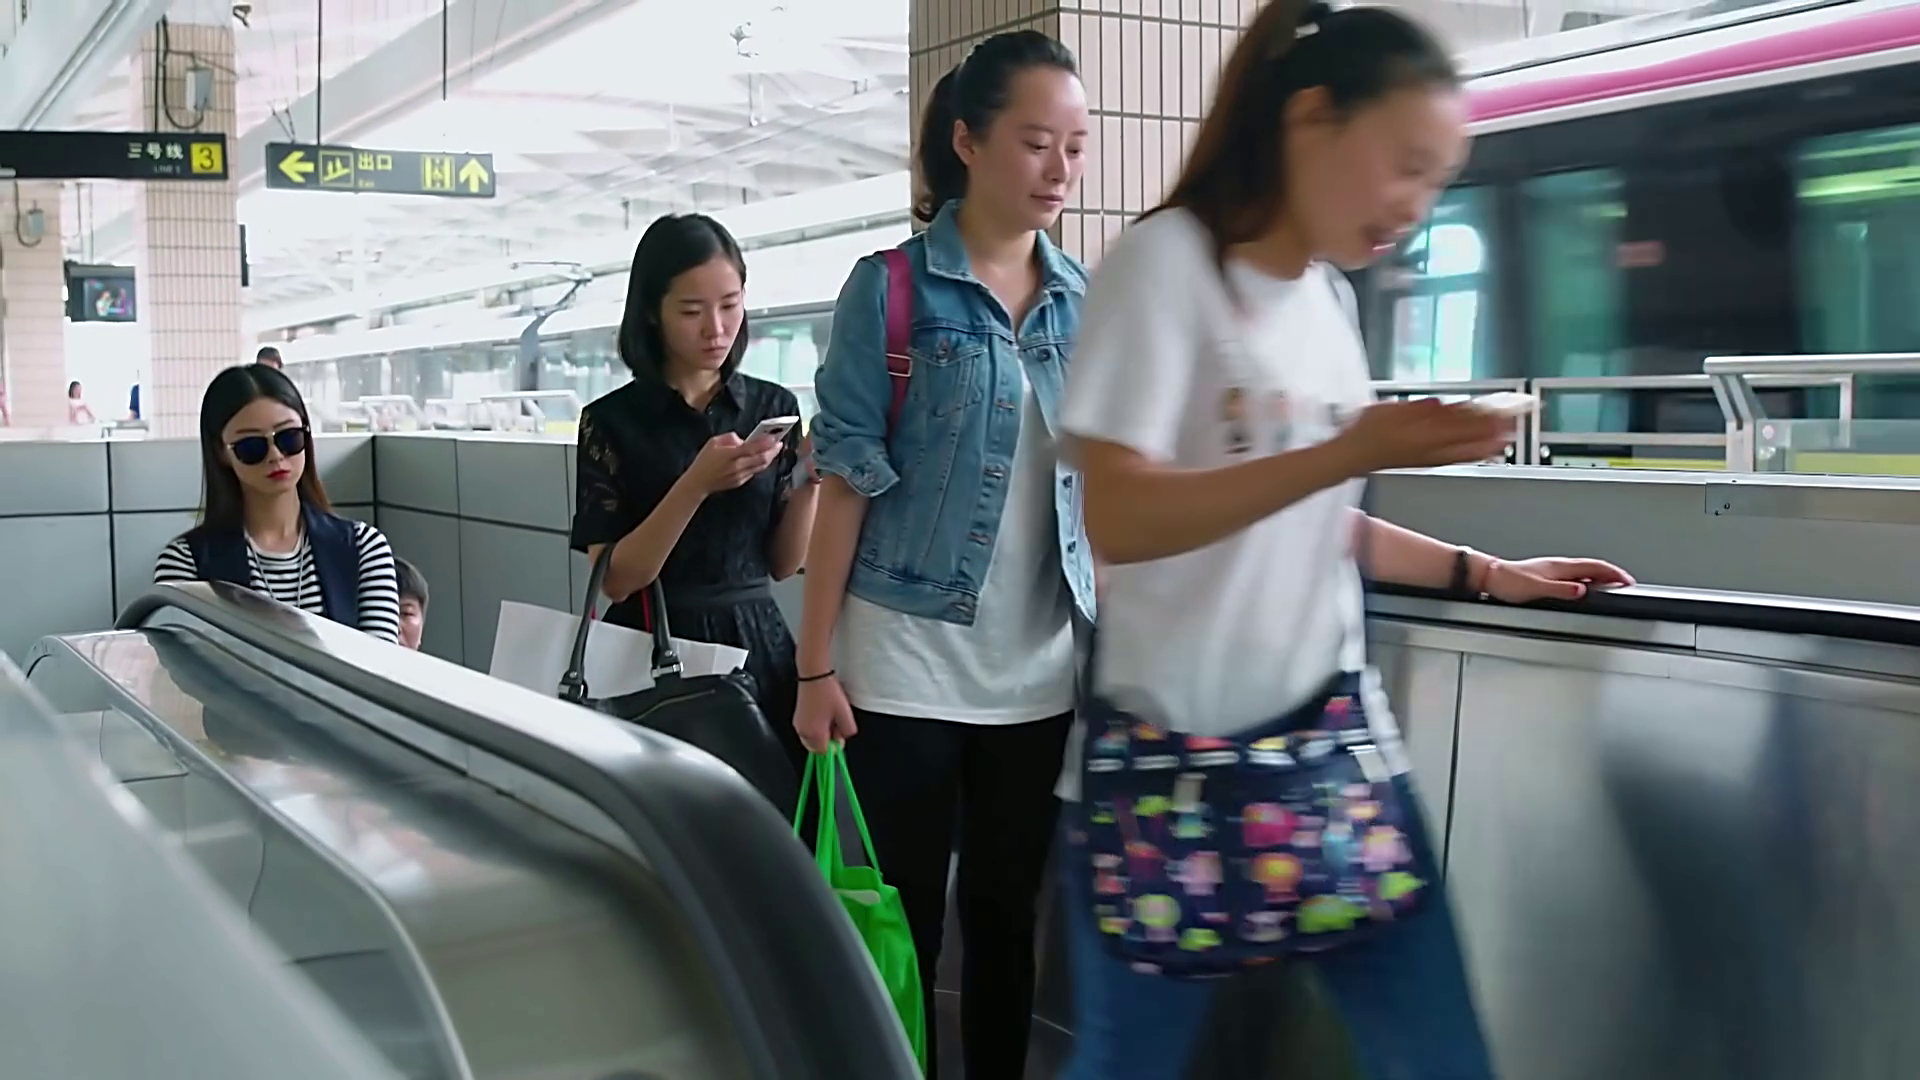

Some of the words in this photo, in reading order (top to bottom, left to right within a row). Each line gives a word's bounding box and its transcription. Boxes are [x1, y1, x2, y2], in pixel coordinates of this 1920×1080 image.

[127, 142, 183, 160] 三号线
[200, 146, 214, 170] 3
[358, 151, 392, 171] 出口
